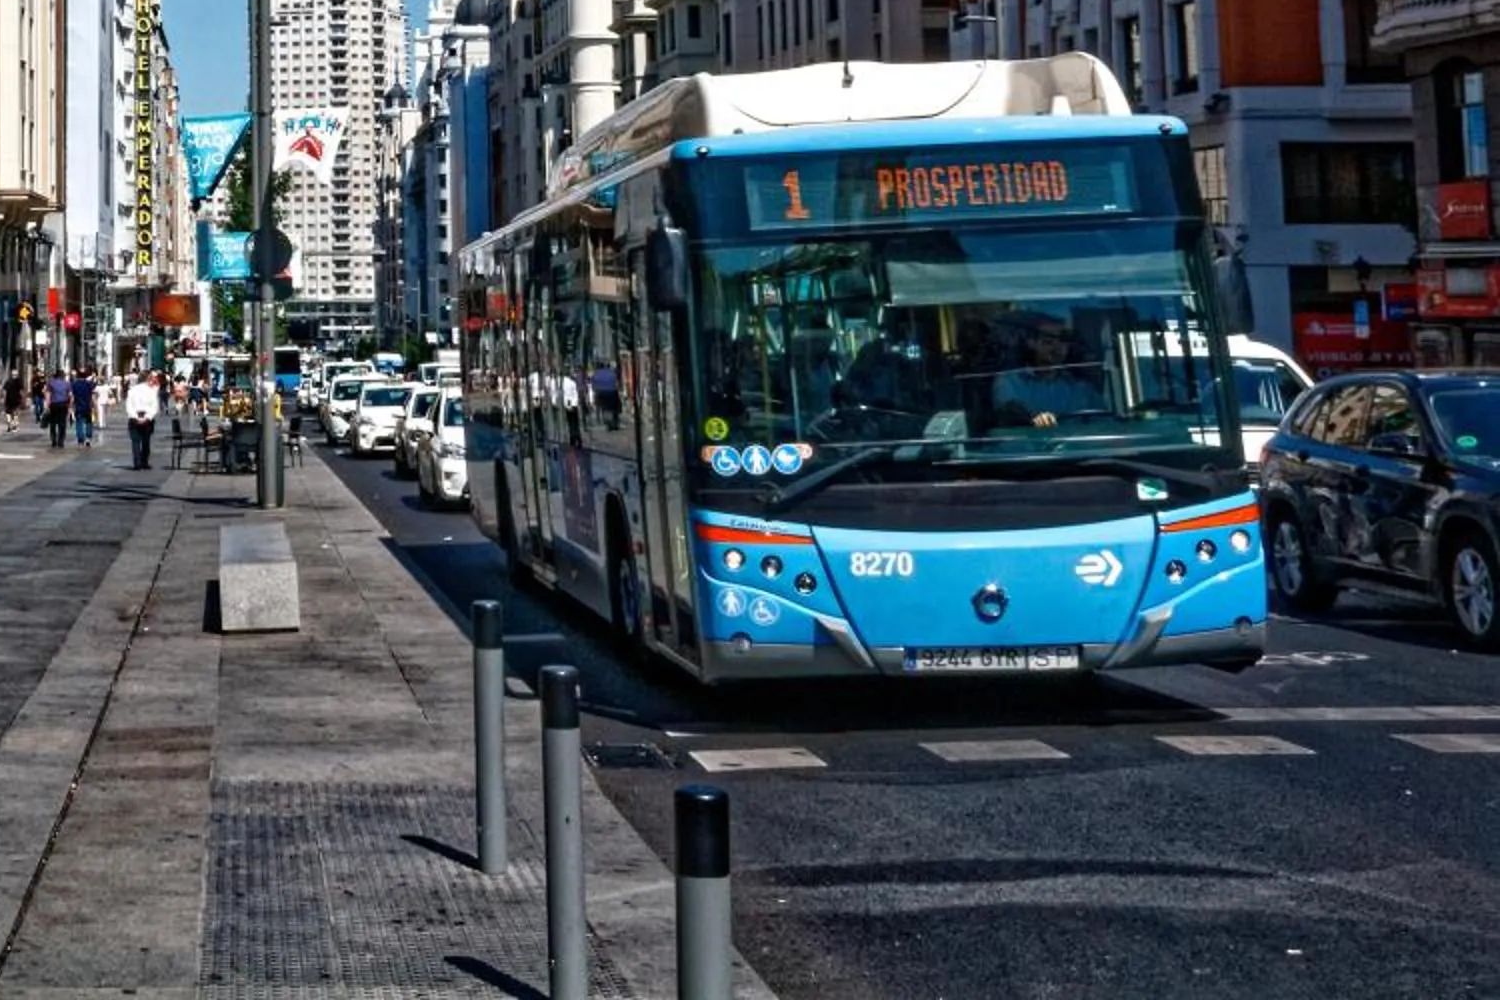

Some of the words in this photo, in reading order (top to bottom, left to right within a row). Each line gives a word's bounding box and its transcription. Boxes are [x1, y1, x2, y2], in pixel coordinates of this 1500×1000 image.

[137, 101, 152, 265] EMPERADOR
[782, 171, 810, 219] 1
[876, 160, 1069, 209] PROSPERIDAD
[850, 551, 914, 577] 8270
[921, 647, 972, 667] 9244
[980, 647, 1018, 667] GYR
[1035, 646, 1073, 668] SP
